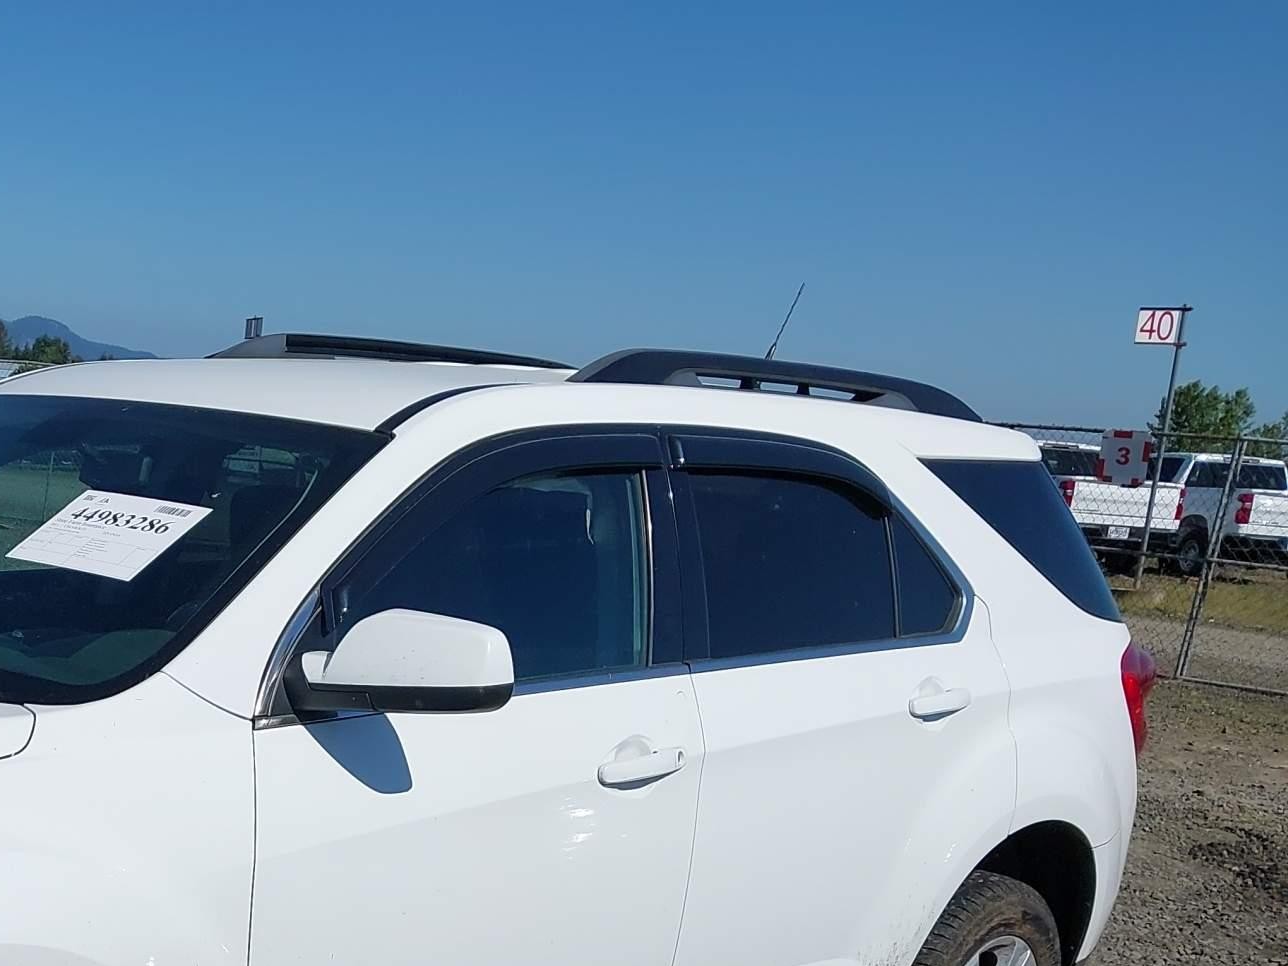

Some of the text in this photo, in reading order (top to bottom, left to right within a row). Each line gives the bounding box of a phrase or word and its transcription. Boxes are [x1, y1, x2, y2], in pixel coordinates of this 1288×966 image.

[1139, 310, 1174, 341] 40
[1115, 446, 1131, 466] 3
[71, 507, 176, 535] 44983286
